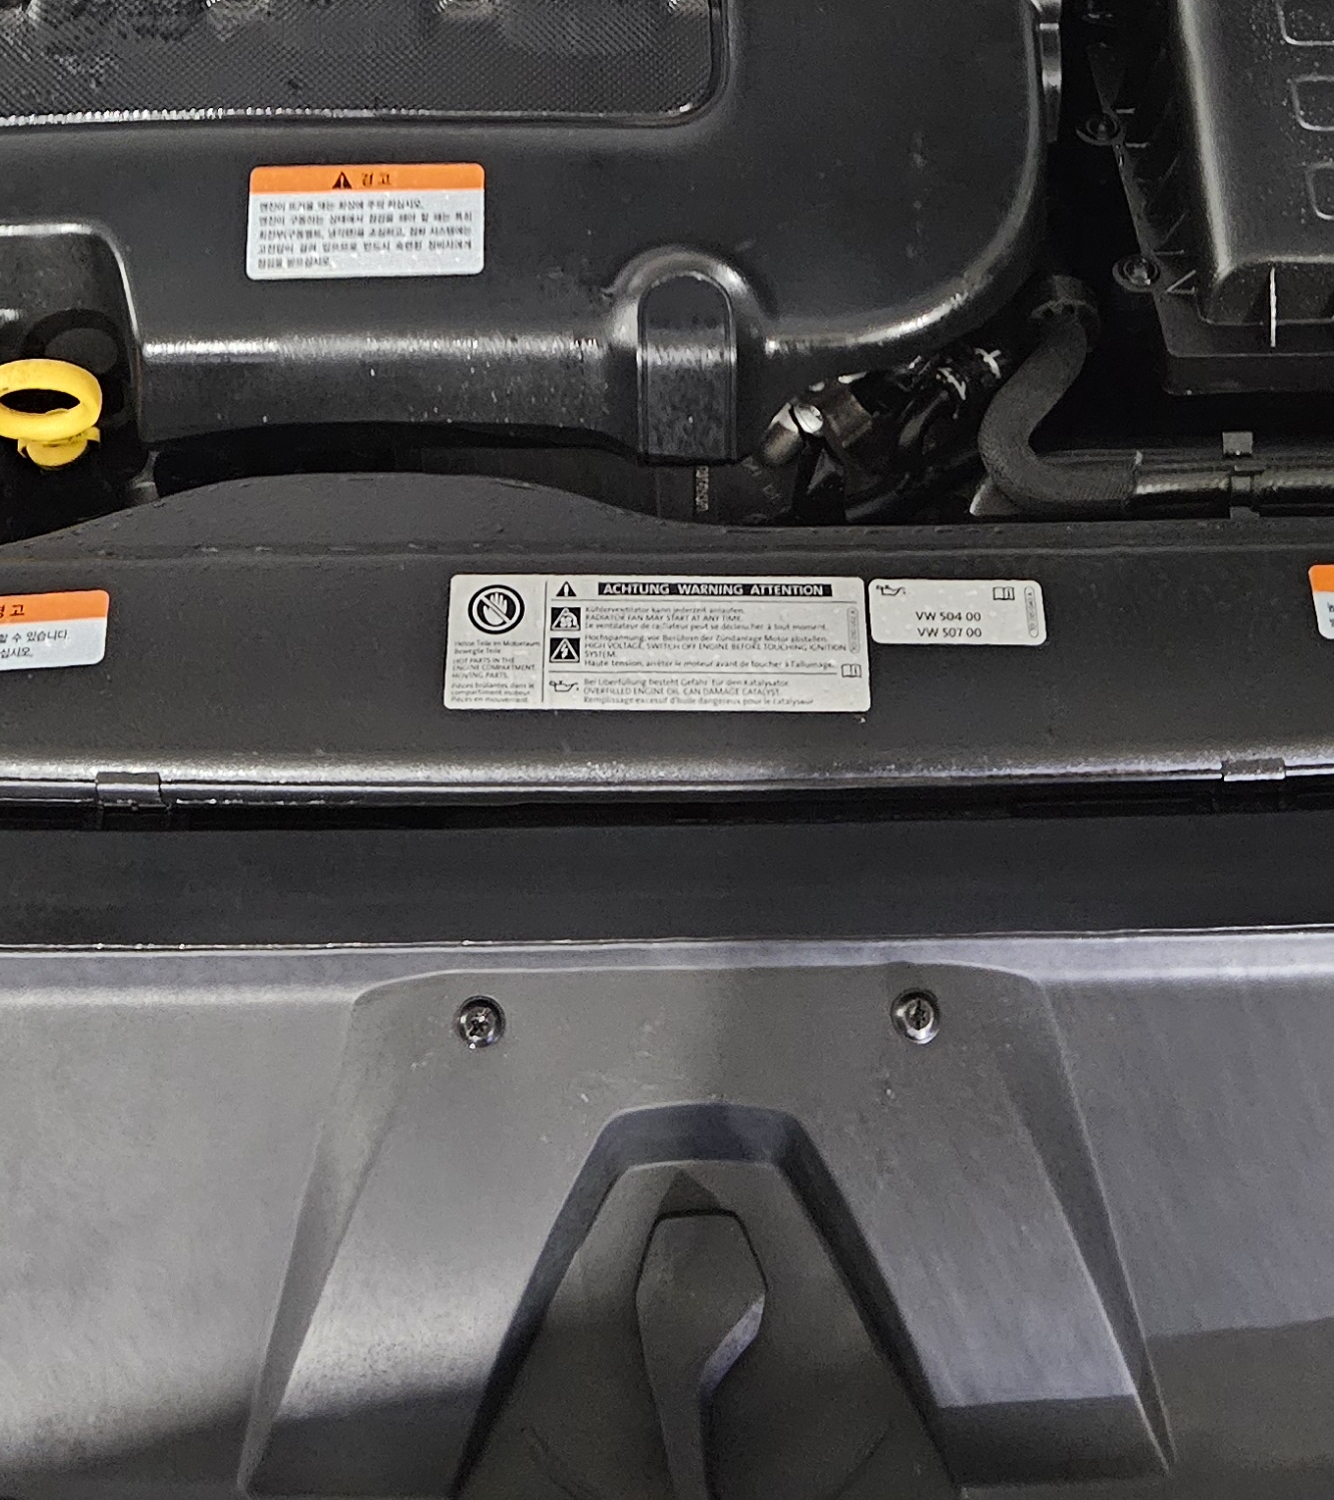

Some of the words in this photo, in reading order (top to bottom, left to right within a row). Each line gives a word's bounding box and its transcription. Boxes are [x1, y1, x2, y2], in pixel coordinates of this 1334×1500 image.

[603, 584, 669, 594] ACHTUNG
[678, 584, 742, 595] WARNING
[750, 585, 823, 595] ATTENTION
[915, 611, 935, 621] VW
[939, 611, 961, 621] 504
[965, 611, 981, 621] 00
[917, 628, 938, 637] VW
[942, 627, 962, 637] 507
[966, 627, 981, 637] 00
